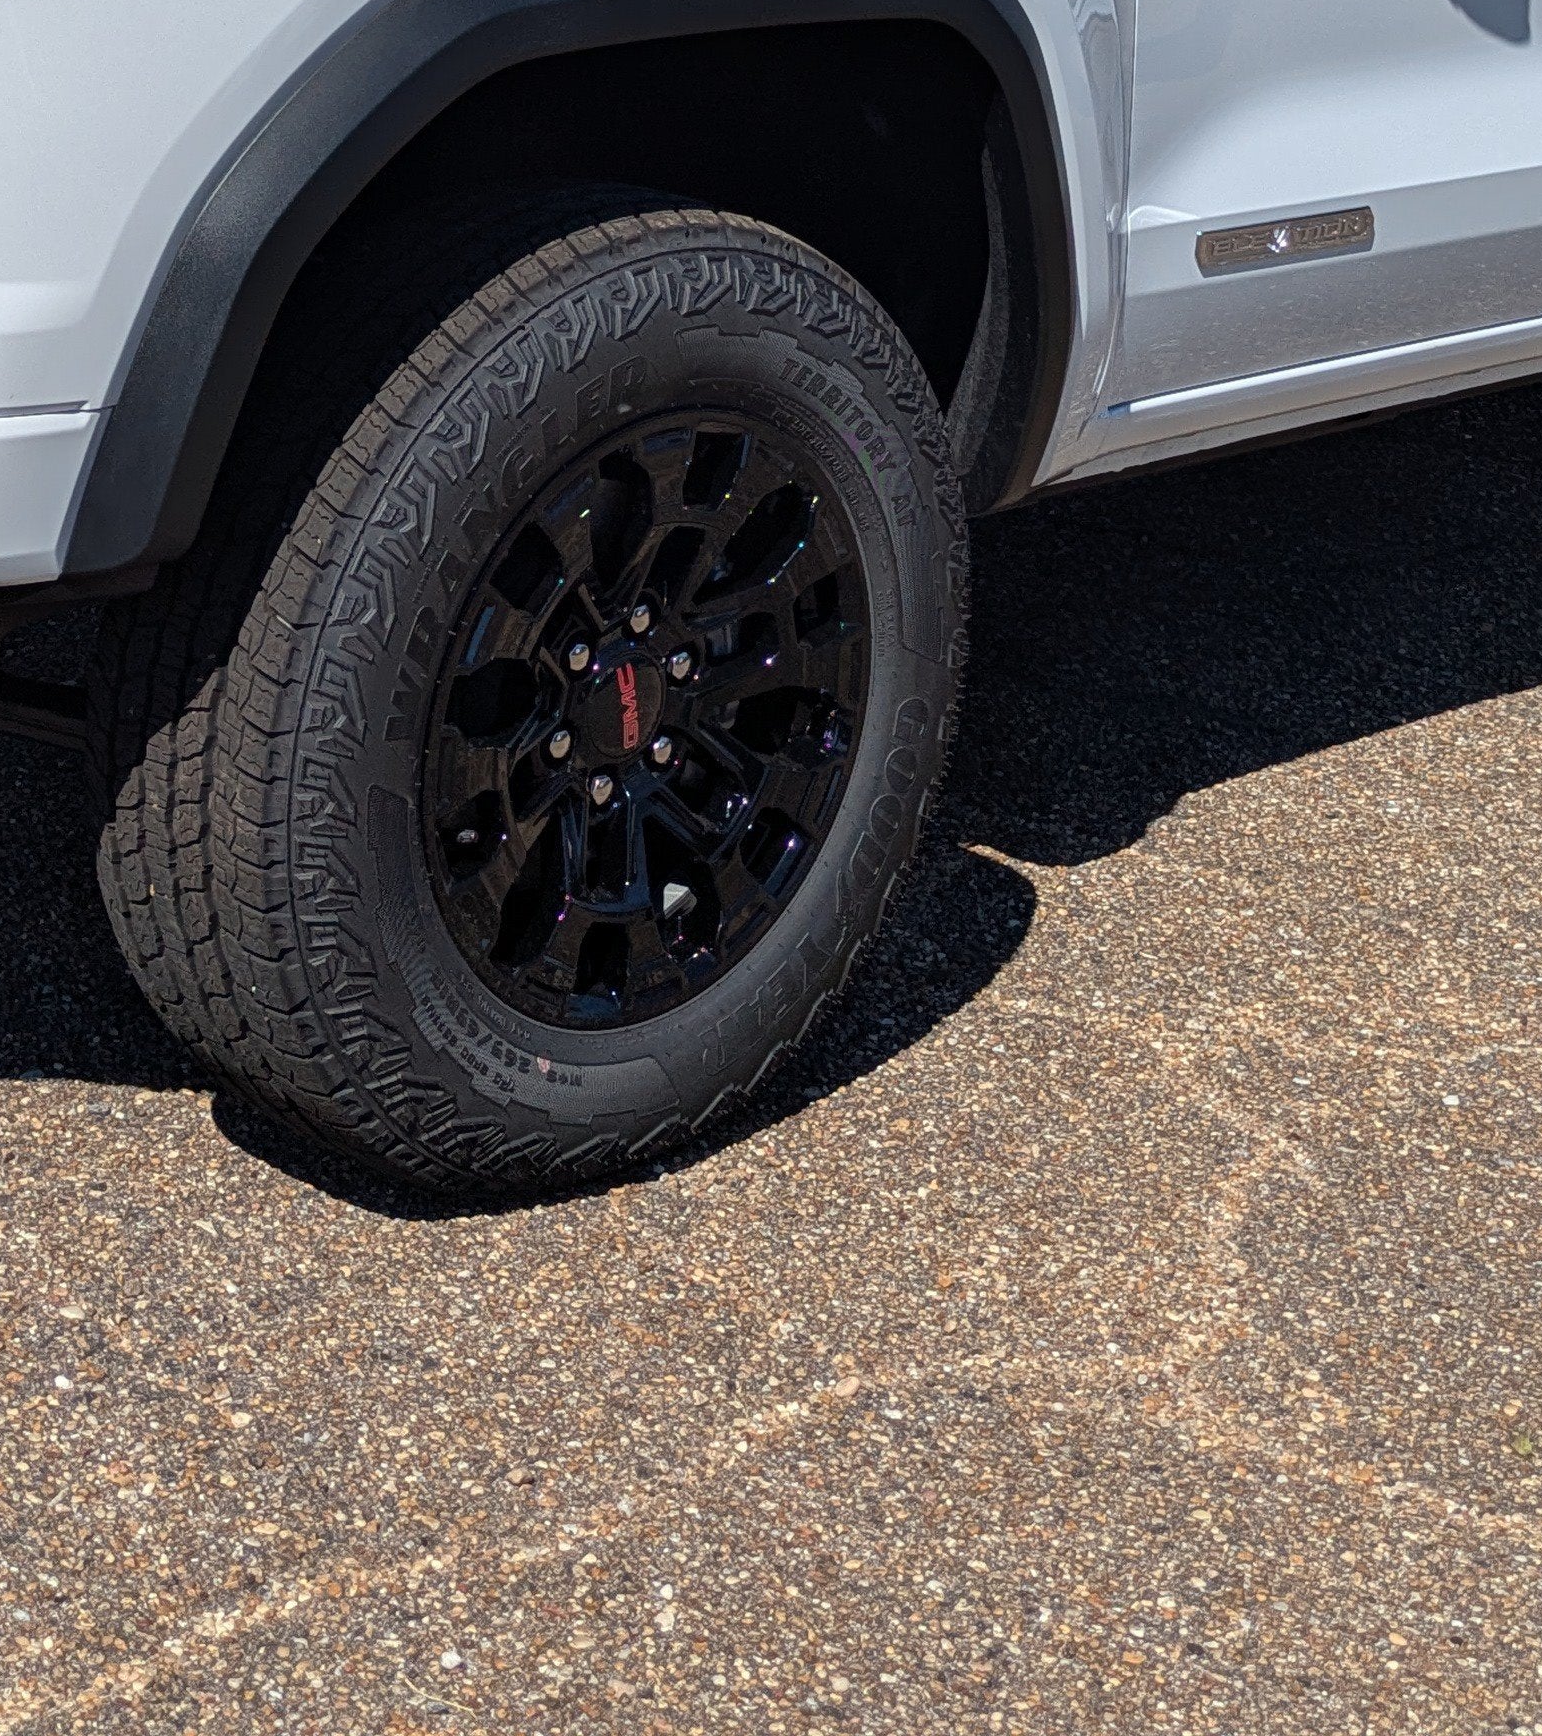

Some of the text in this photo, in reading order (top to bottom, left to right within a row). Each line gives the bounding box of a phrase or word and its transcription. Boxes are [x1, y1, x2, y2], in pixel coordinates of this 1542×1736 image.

[780, 357, 897, 476] TERRITORY
[384, 353, 645, 741] WRANGLER
[615, 662, 639, 750] GMC
[699, 696, 931, 1078] GOODYEAR
